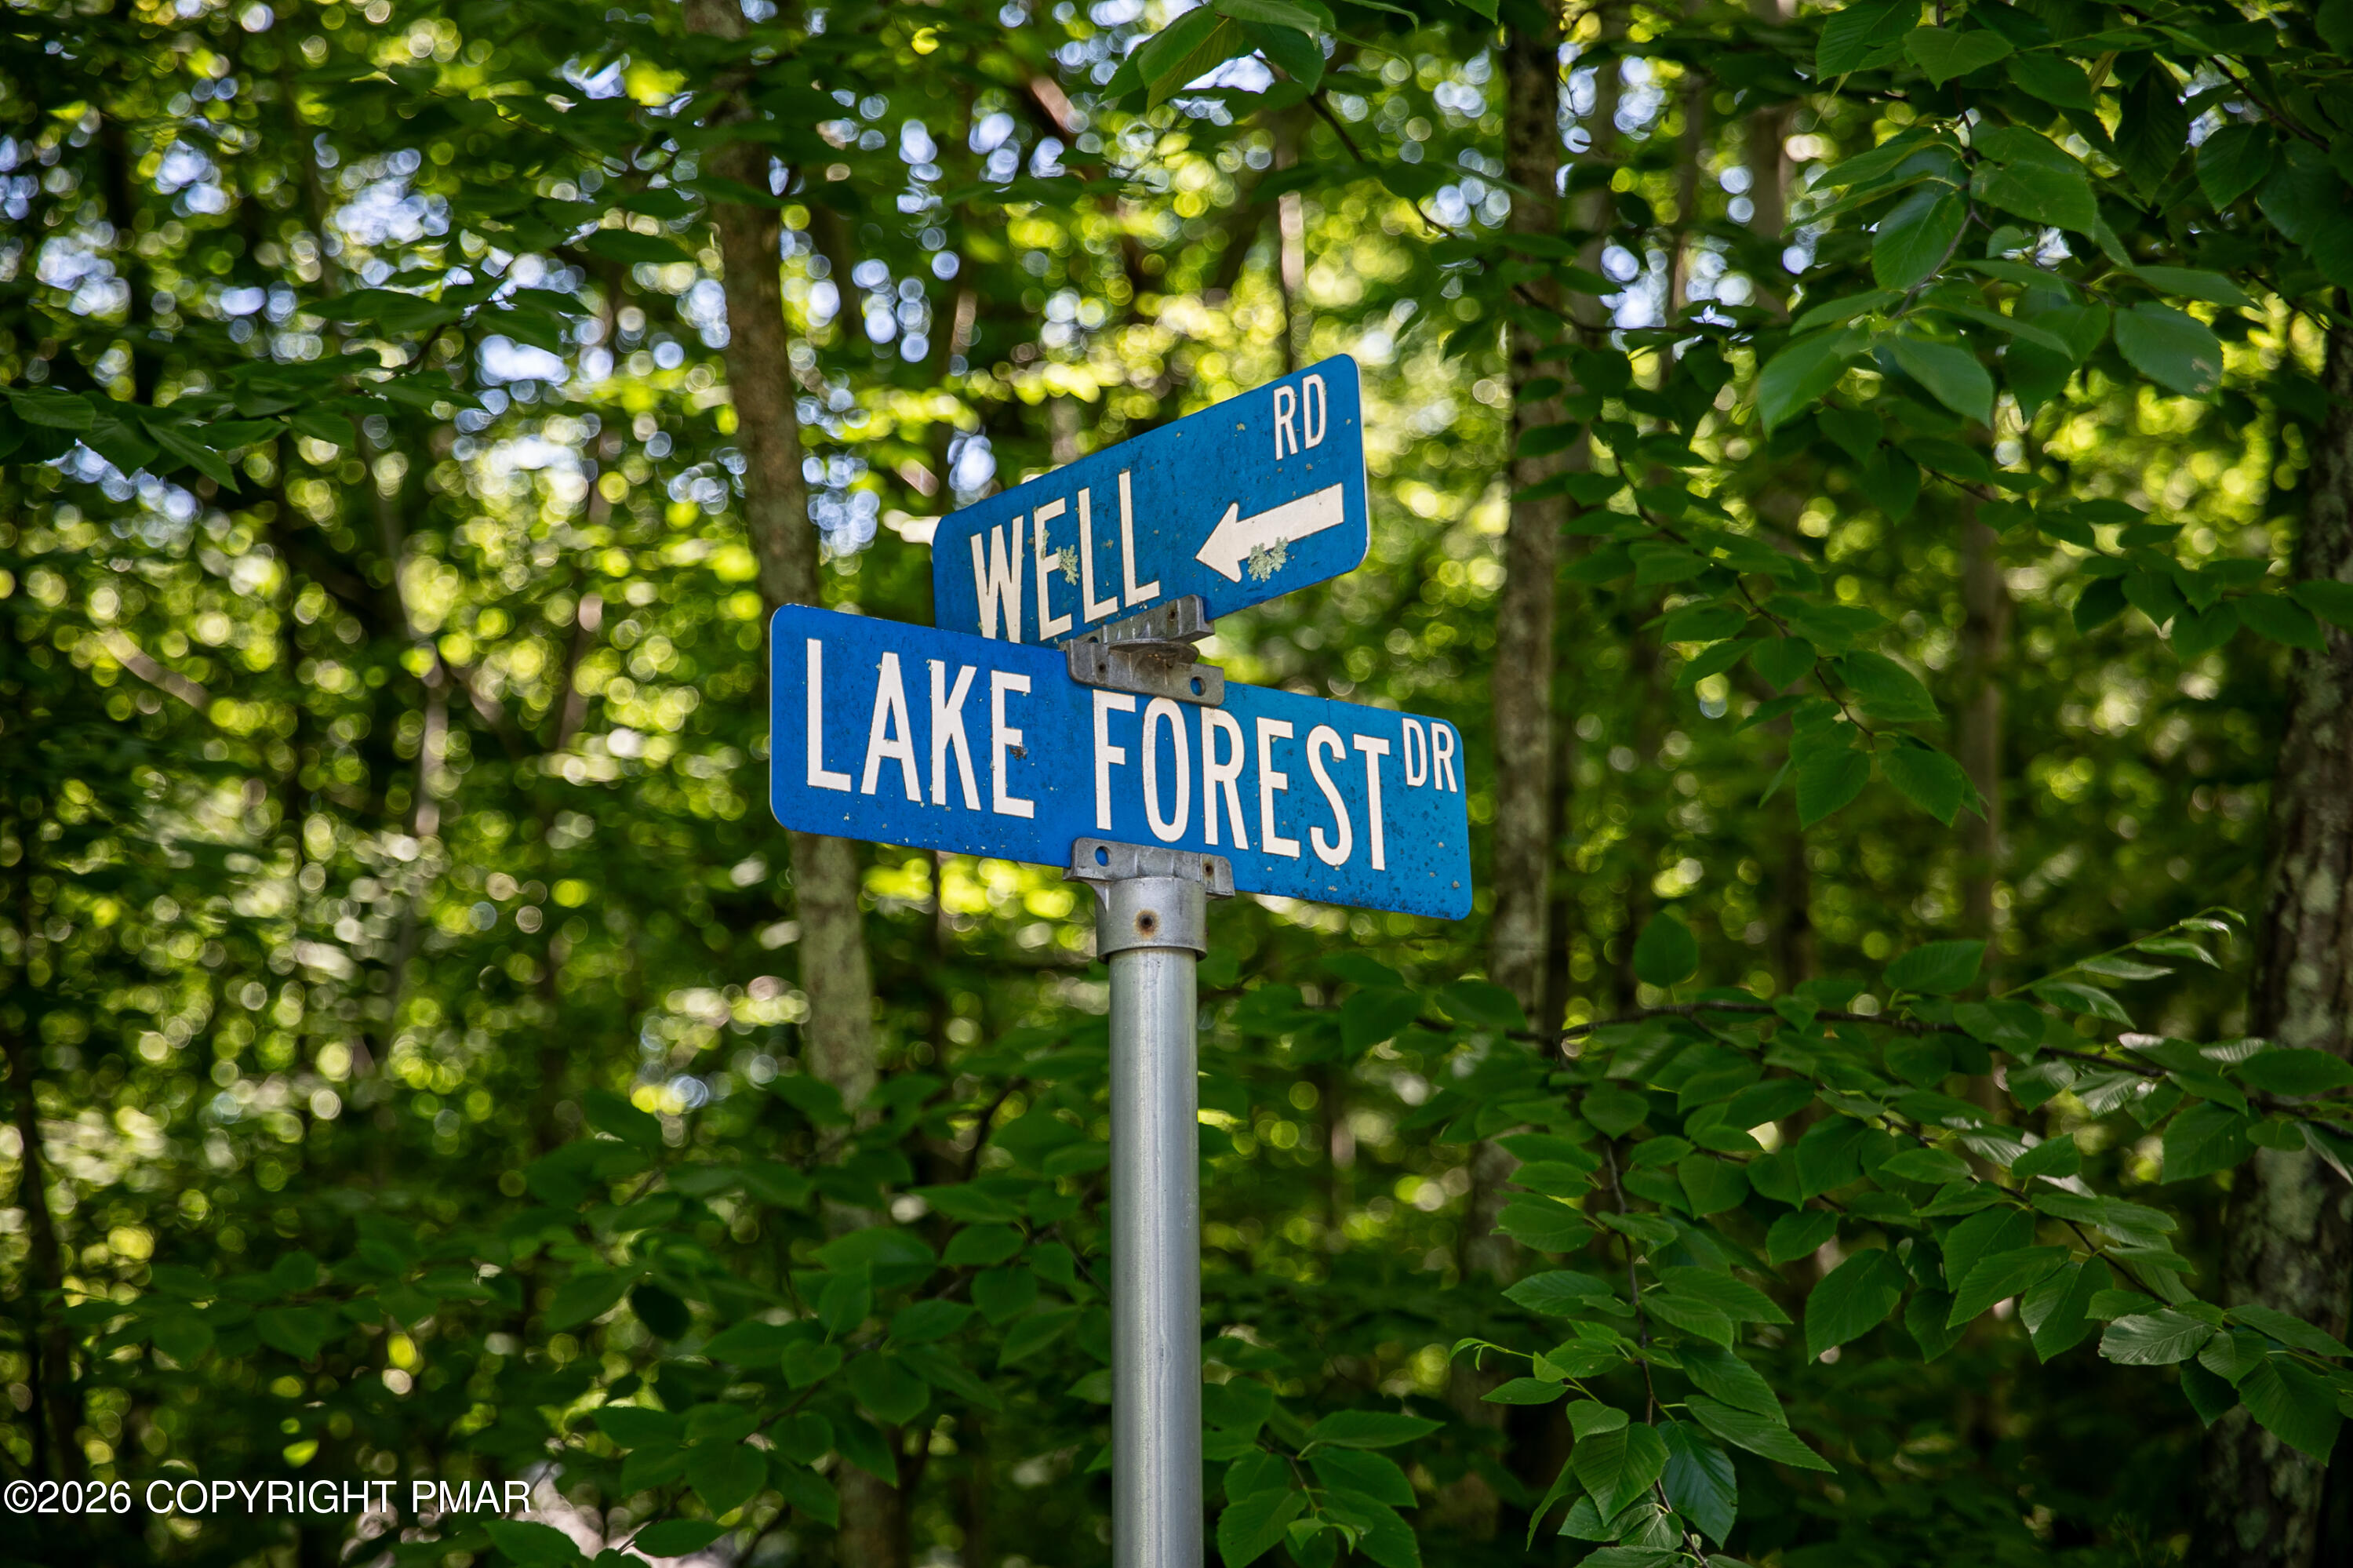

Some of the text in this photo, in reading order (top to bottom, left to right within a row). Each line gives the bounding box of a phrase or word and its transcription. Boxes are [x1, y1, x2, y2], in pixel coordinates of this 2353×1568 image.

[970, 373, 1326, 643] WELL RD
[806, 638, 1458, 871] LAKE FOREST DR
